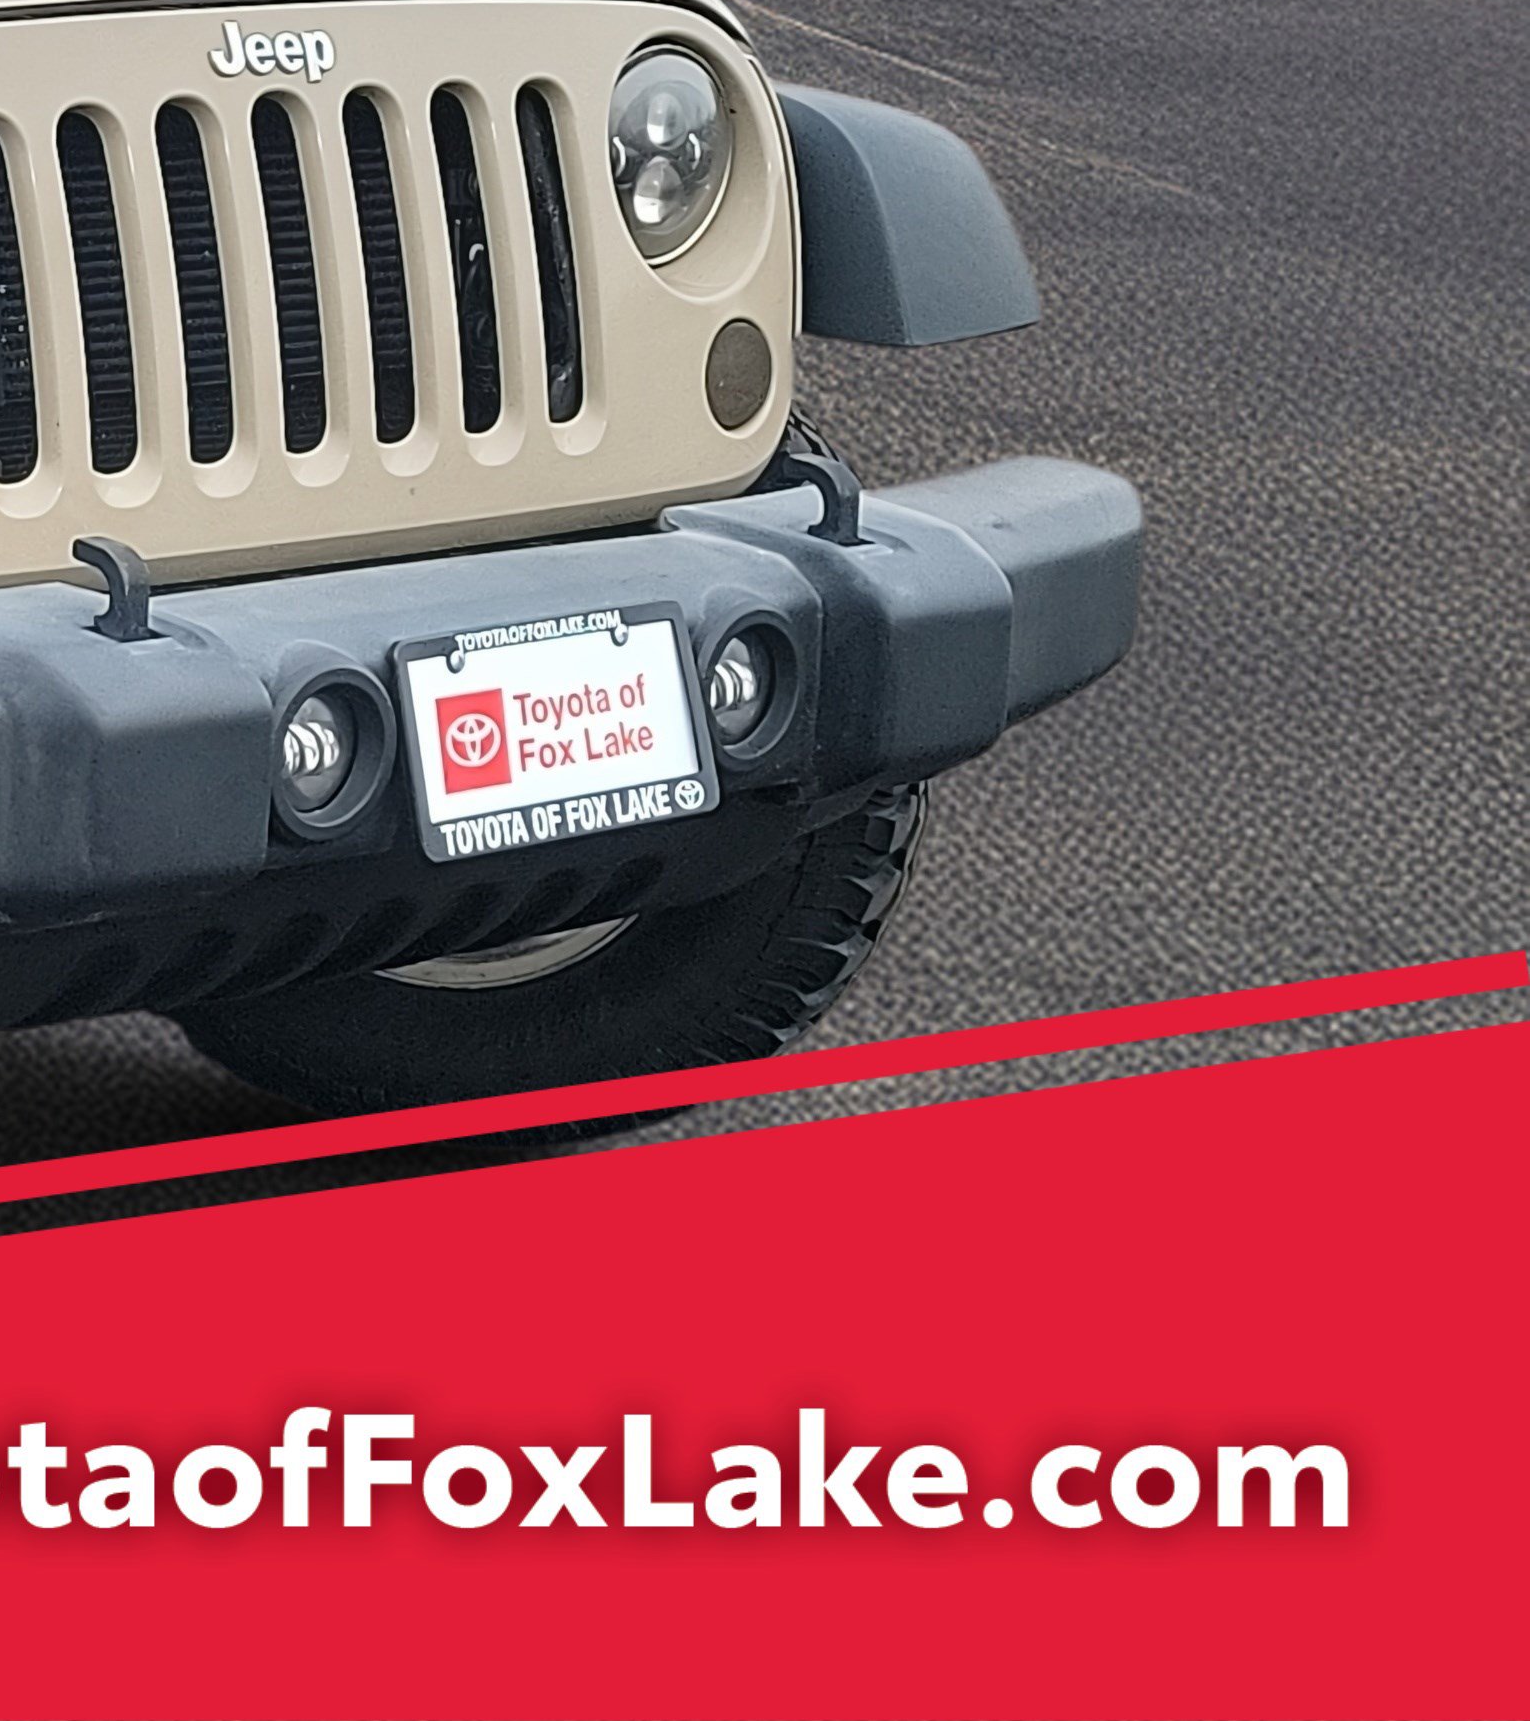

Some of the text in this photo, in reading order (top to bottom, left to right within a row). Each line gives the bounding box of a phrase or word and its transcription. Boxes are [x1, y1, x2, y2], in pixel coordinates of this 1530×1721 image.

[207, 20, 336, 83] Jeep
[513, 673, 647, 731] Toyota of
[518, 721, 654, 772] Fox Lake
[440, 783, 673, 856] TOYOTA OF FOX LAKE
